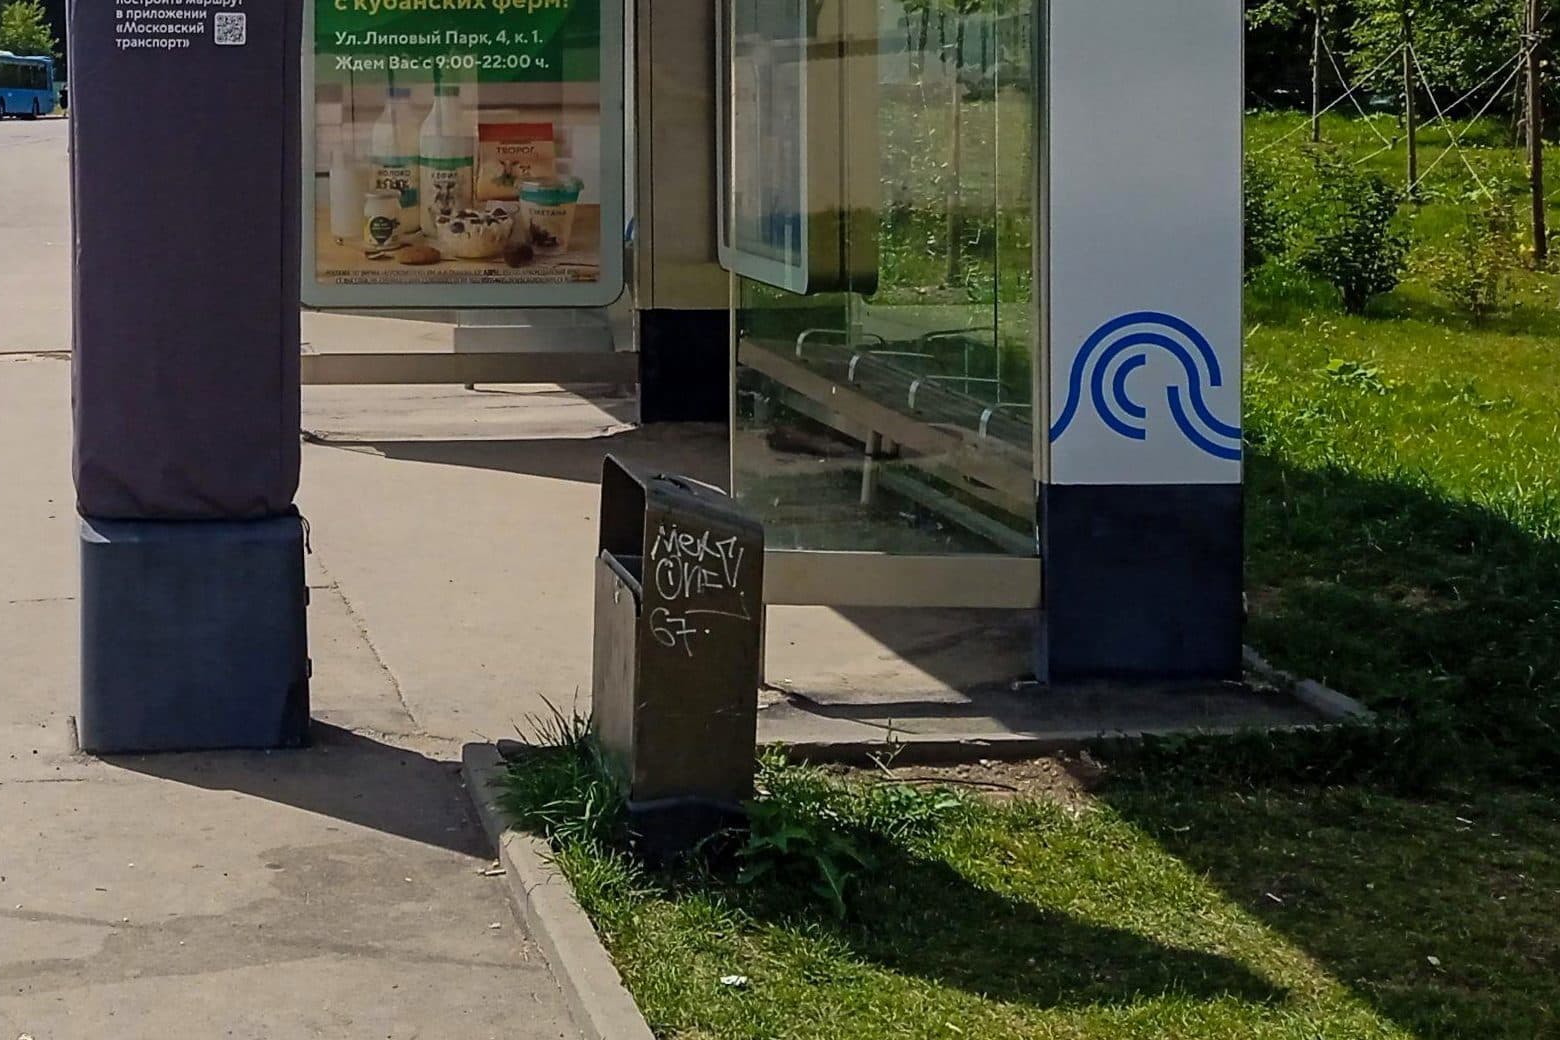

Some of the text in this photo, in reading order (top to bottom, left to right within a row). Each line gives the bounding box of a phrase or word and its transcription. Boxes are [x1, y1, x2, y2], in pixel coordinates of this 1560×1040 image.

[116, 9, 207, 21] в приложении
[116, 22, 205, 33] «Московский
[116, 37, 190, 50] транспорт»
[335, 29, 543, 49] Ул. Липовый Парк, 4, к. 1.
[335, 55, 549, 72] Ждем Вас с 9:00-22:00 ч.
